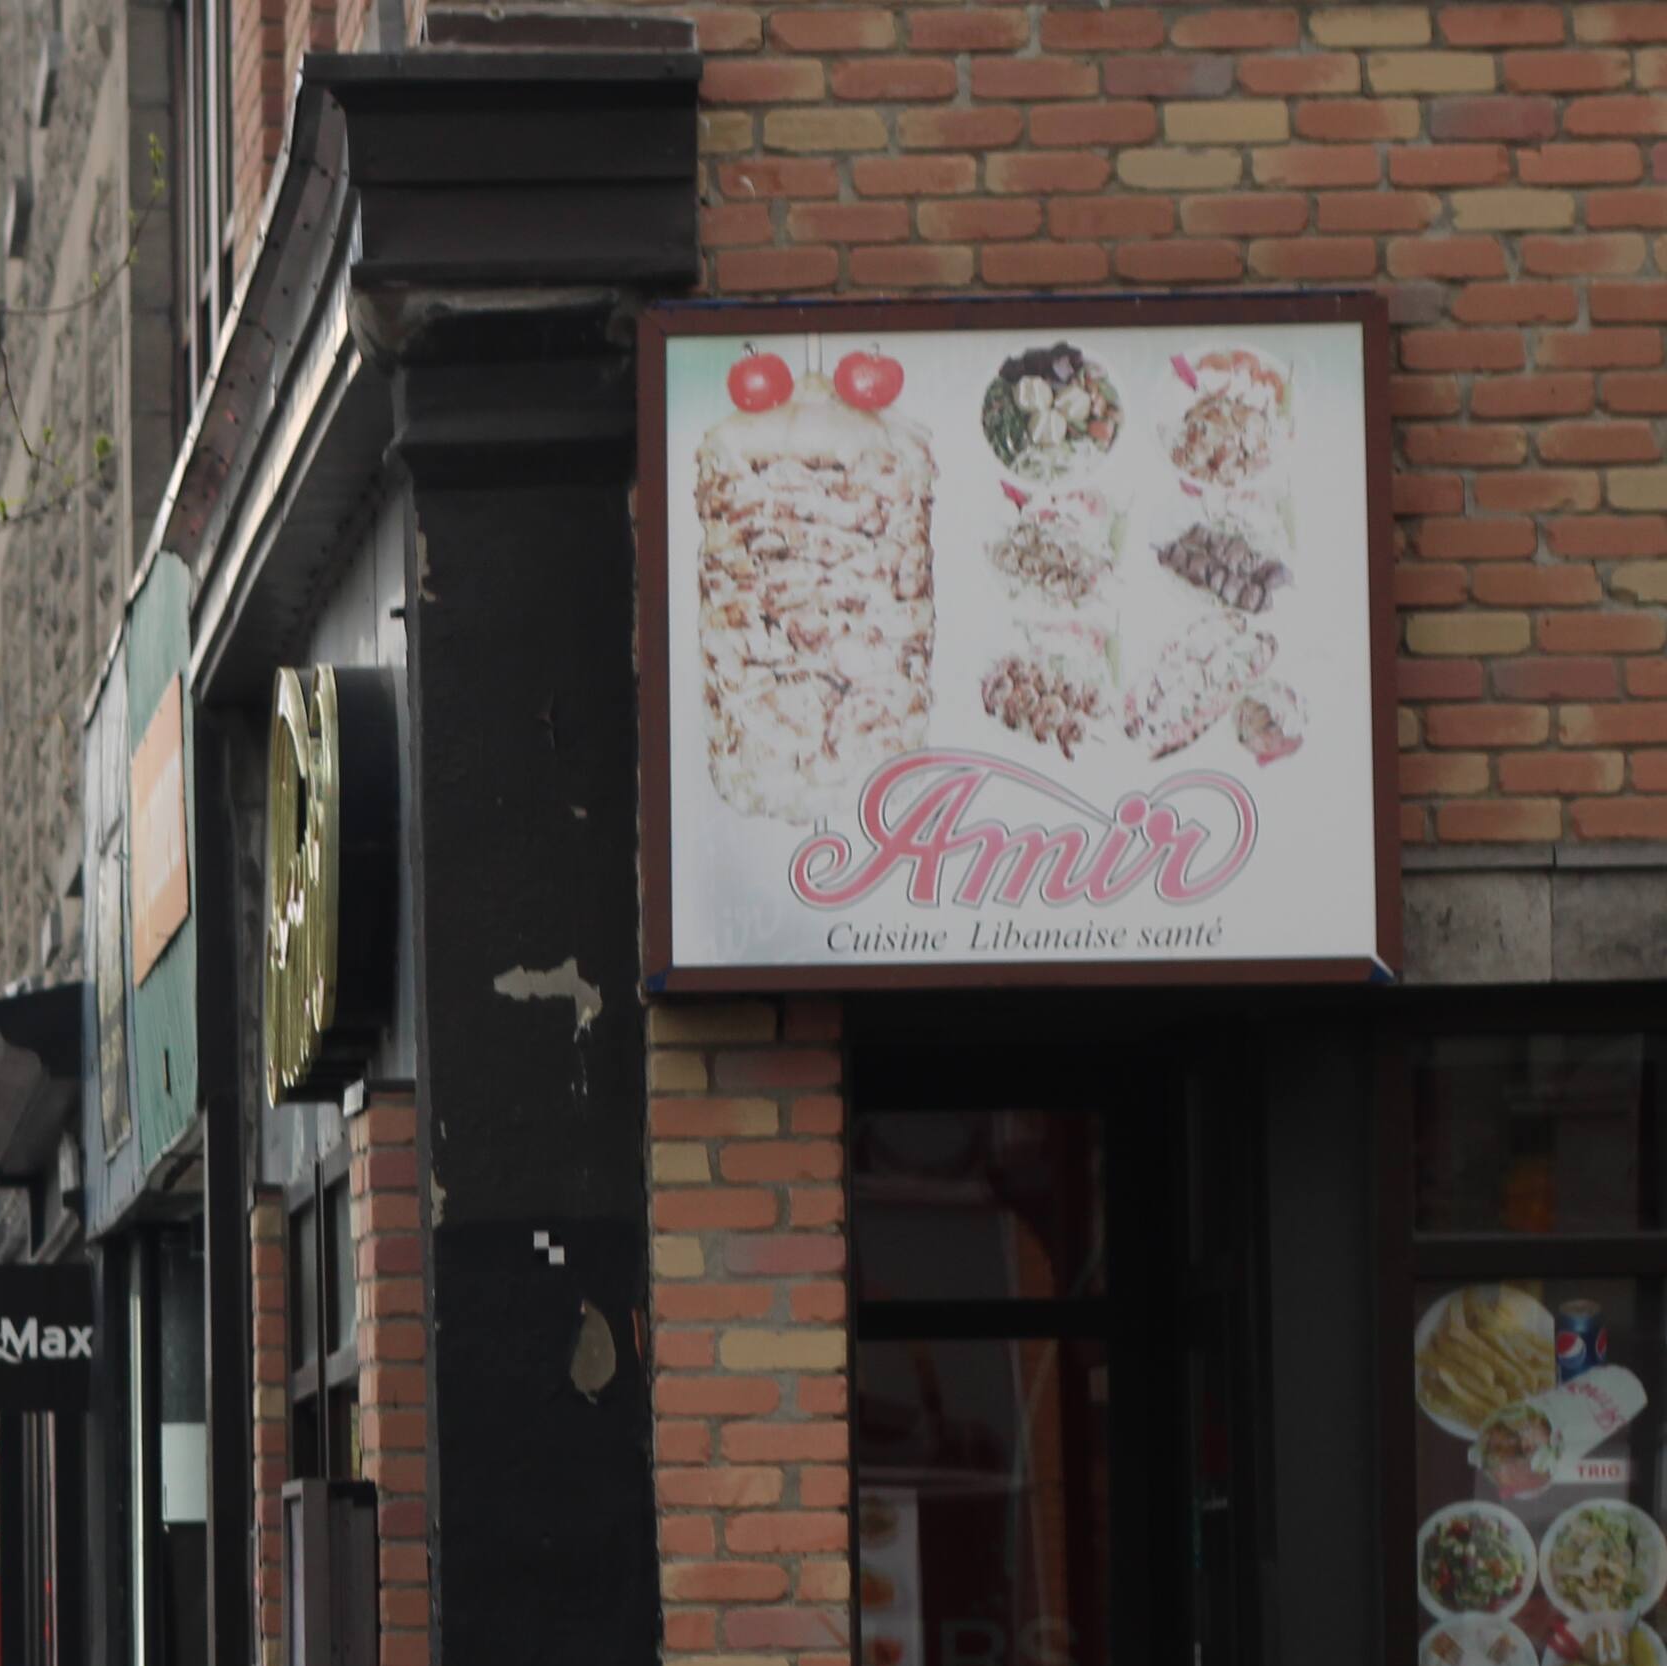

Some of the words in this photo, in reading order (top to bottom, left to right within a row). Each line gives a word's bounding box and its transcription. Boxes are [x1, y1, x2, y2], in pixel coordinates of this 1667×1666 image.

[789, 747, 1258, 910] Amir
[826, 922, 948, 954] Cuisine
[969, 920, 1128, 952] Libanaise
[1137, 916, 1223, 948] santé
